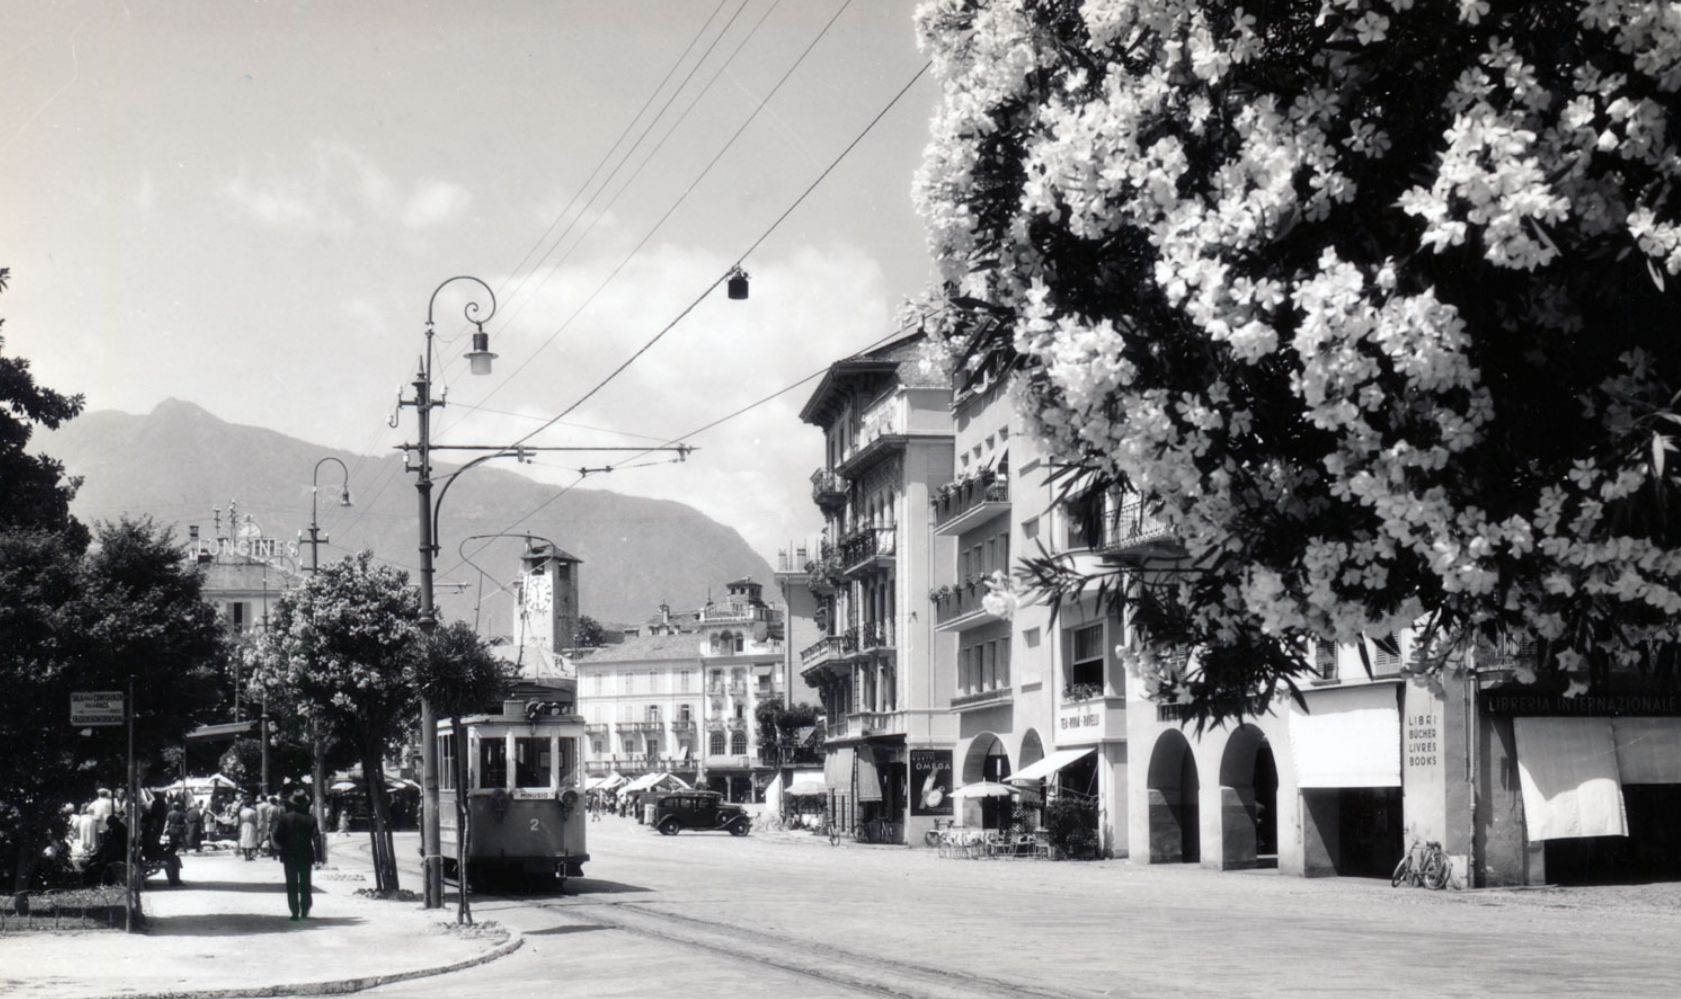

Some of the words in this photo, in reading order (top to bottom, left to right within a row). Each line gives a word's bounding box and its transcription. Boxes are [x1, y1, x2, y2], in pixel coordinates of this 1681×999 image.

[198, 538, 299, 557] LONGINES
[1488, 696, 1550, 712] LIBRERIA
[1557, 696, 1677, 713] INTERNAZIONALE
[1408, 714, 1437, 726] LIBRI
[1408, 742, 1437, 753] LIVRES
[915, 762, 951, 771] OMEGA
[1408, 755, 1437, 767] BOOKS
[530, 818, 540, 832] 2
